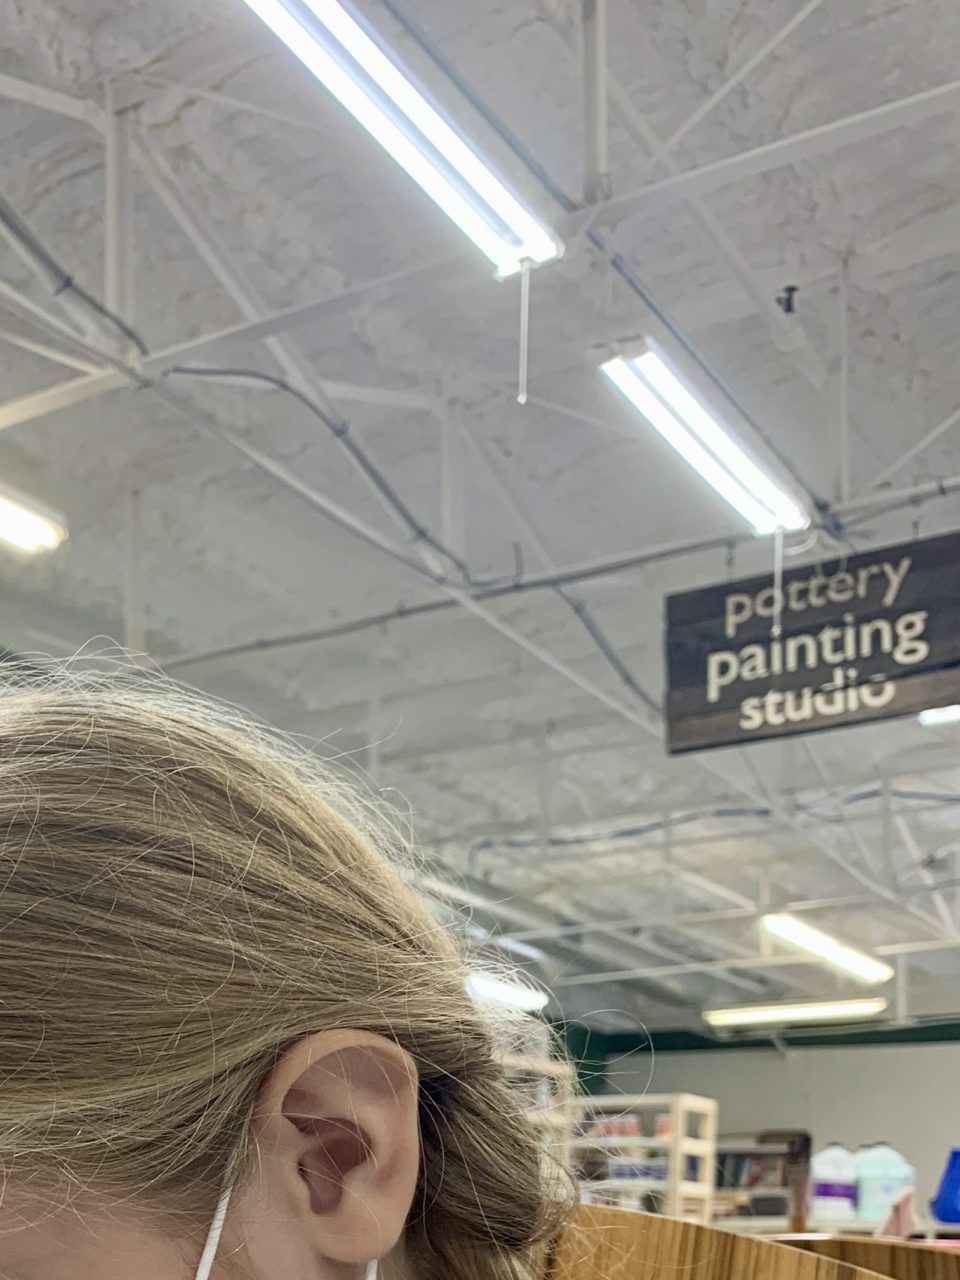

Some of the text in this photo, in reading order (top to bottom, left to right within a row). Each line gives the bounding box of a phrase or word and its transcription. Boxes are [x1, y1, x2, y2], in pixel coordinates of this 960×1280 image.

[725, 556, 912, 638] pottery
[706, 610, 930, 702] painting
[739, 667, 897, 730] studio
